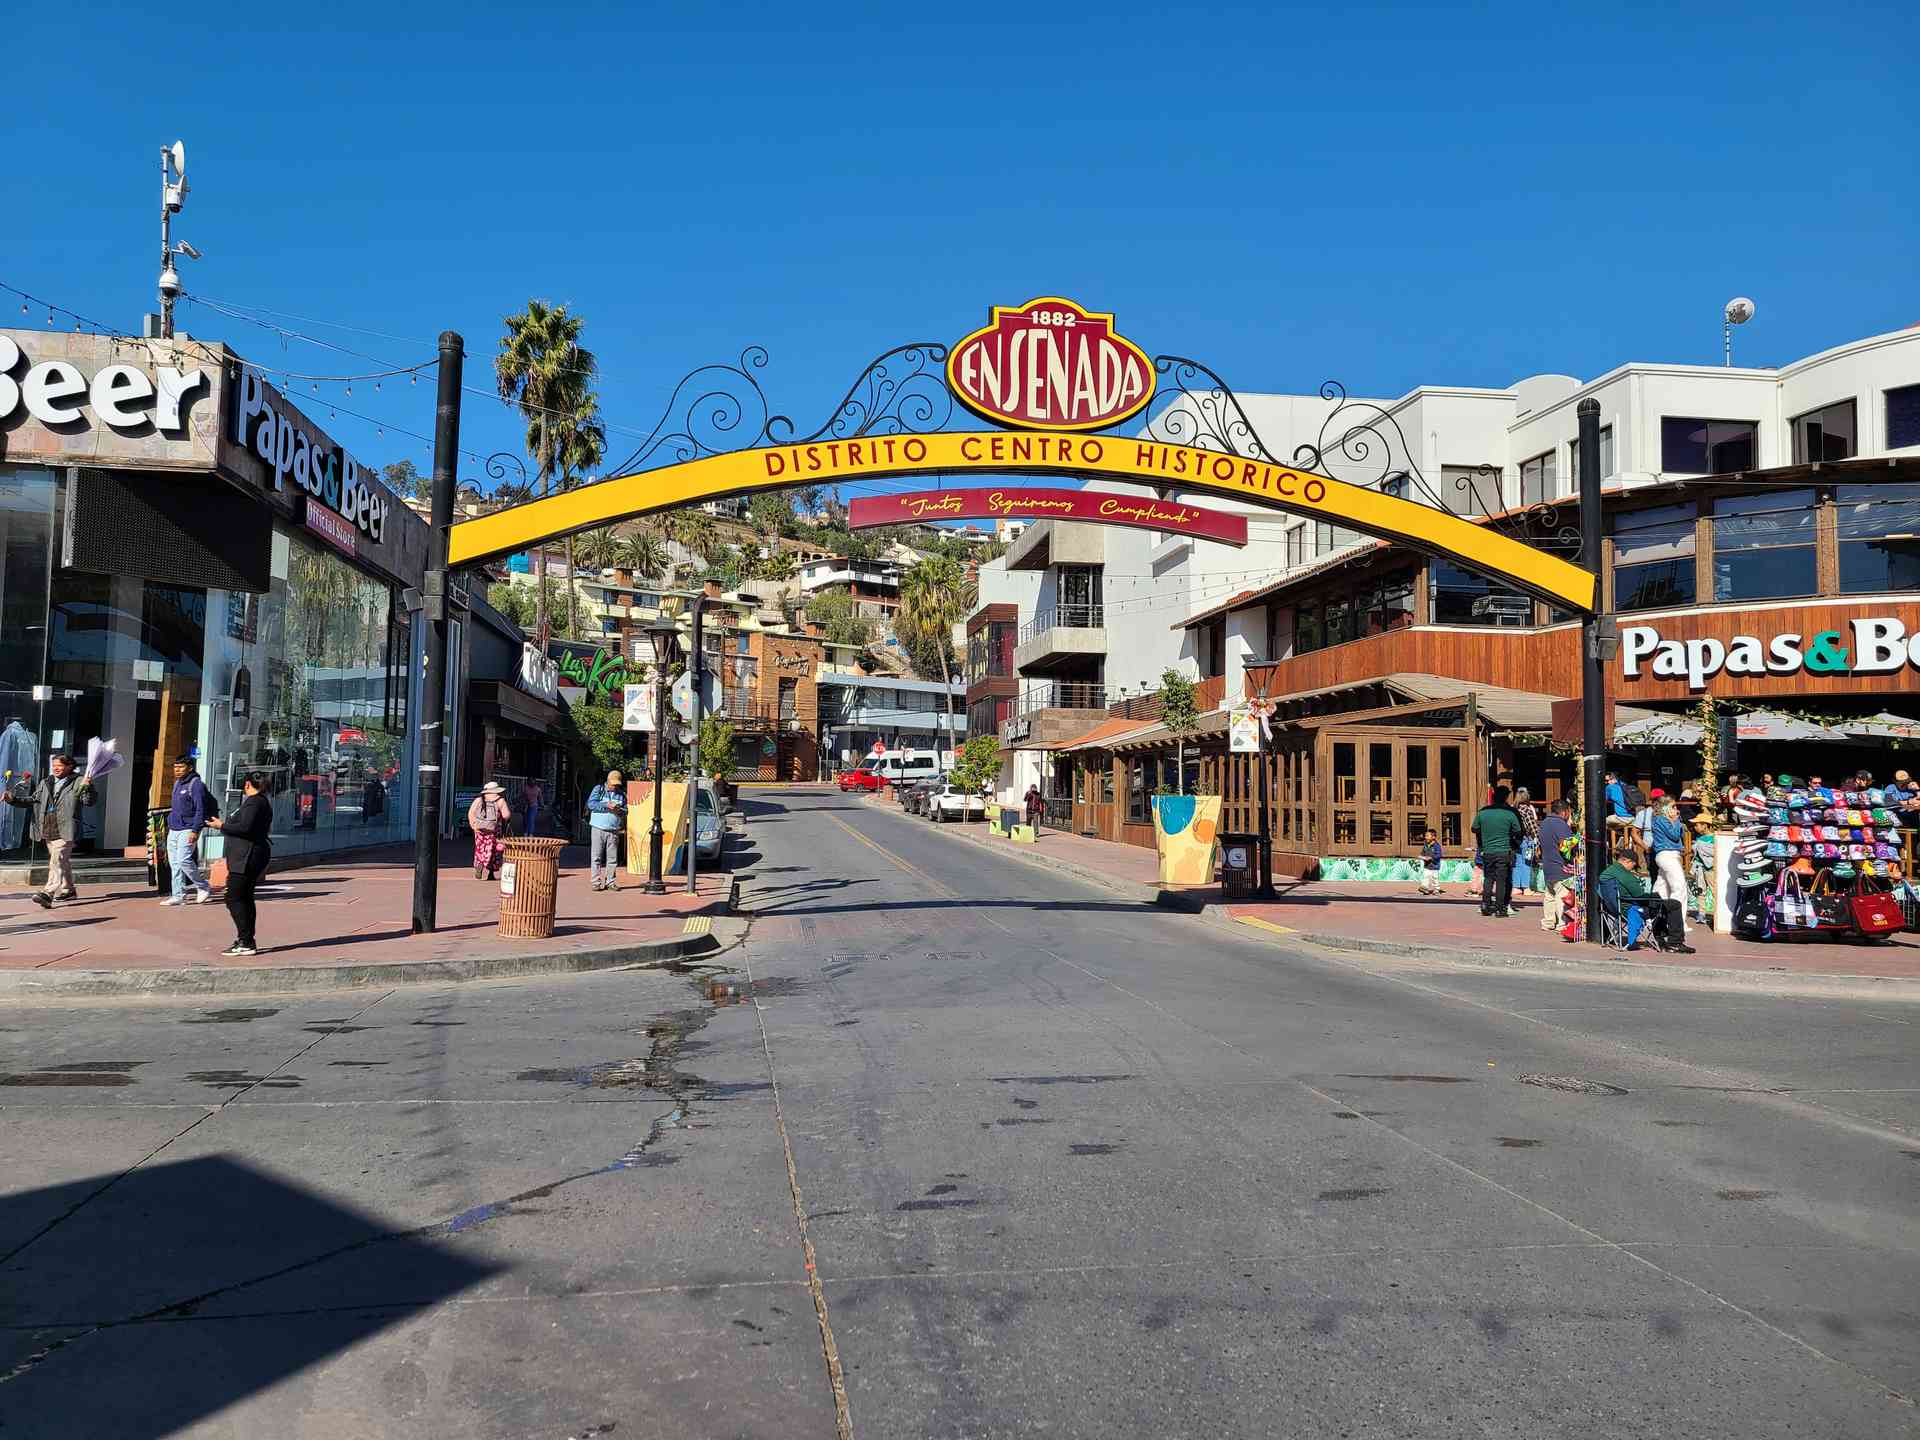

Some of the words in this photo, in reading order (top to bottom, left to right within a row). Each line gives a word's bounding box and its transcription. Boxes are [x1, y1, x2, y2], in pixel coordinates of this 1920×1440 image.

[1031, 310, 1076, 327] 1882
[961, 328, 1143, 420] ENSENADA
[765, 438, 927, 476] DISTRITO
[960, 437, 1103, 463] CENTRO
[1136, 439, 1326, 503] HISTORICO
[335, 522, 355, 549] Store
